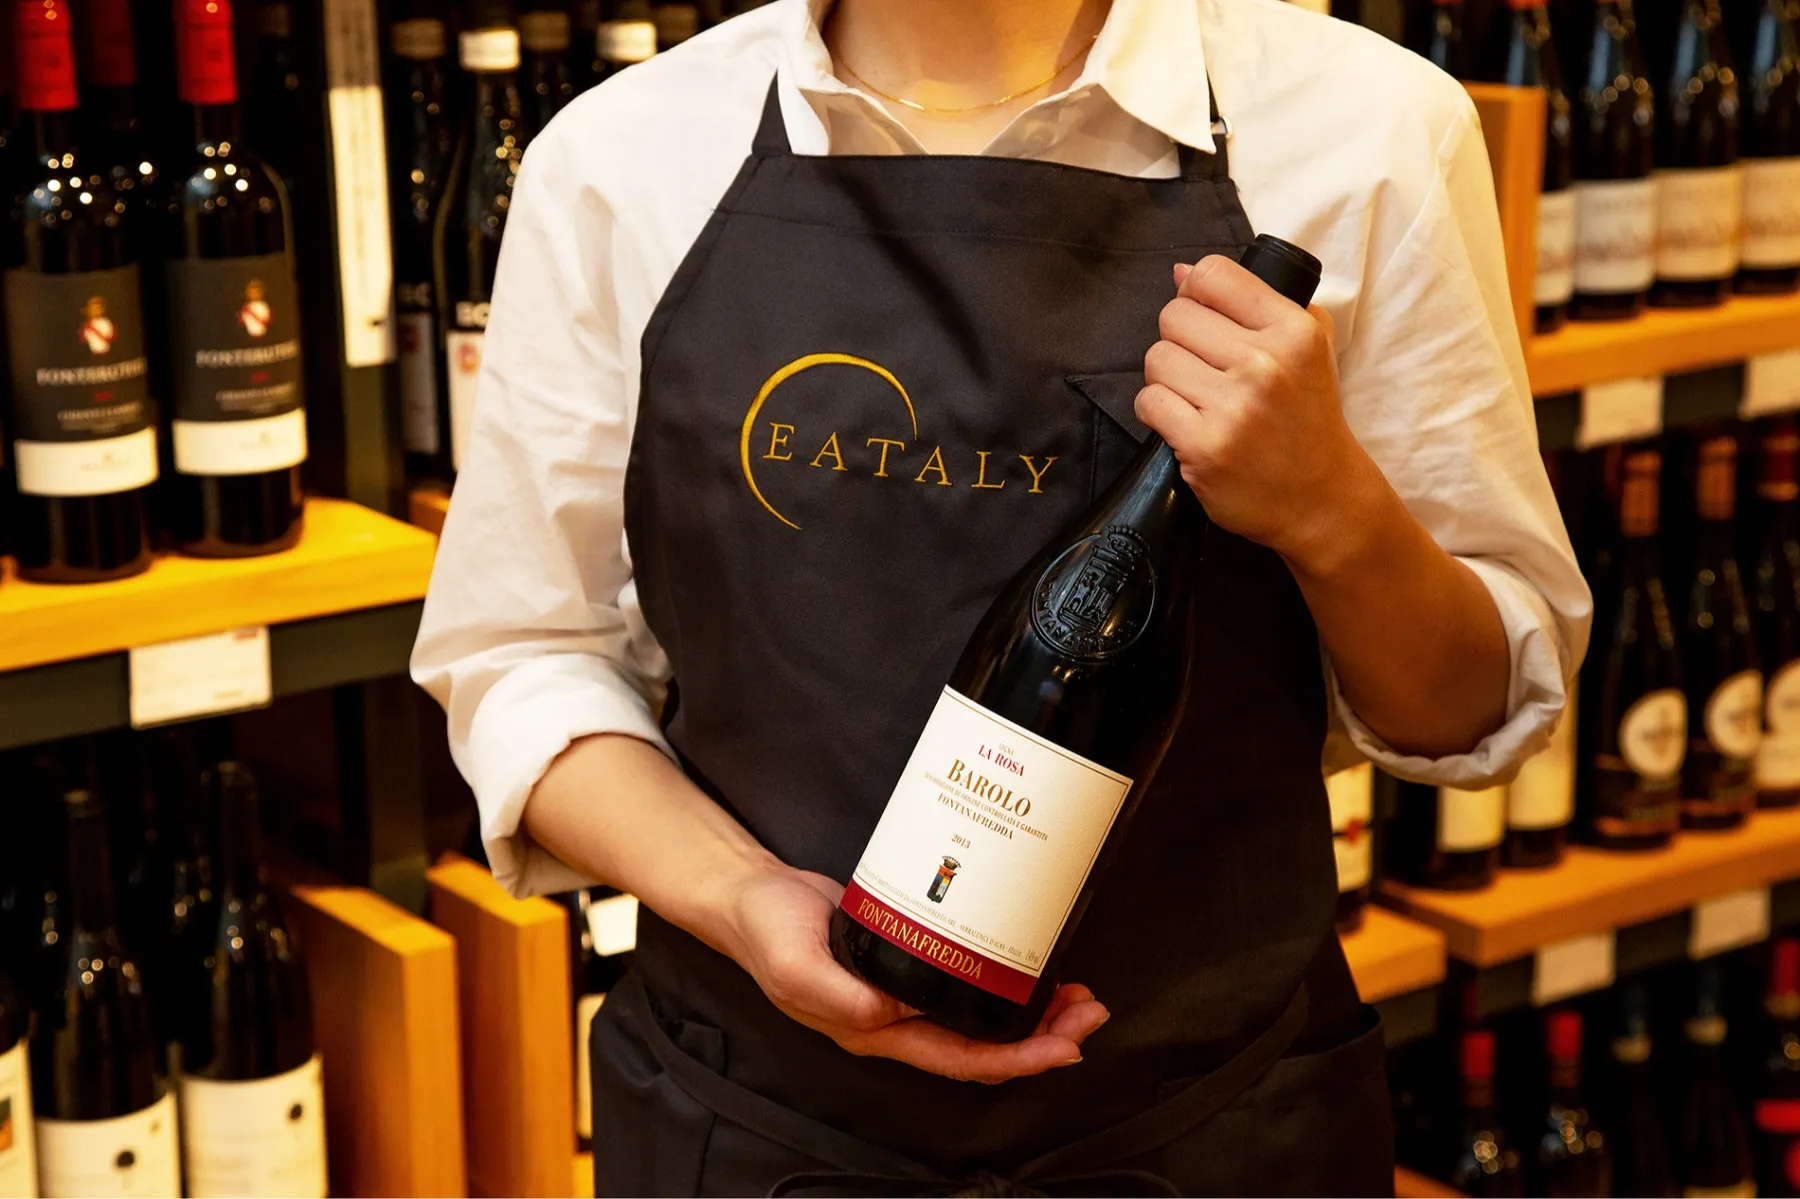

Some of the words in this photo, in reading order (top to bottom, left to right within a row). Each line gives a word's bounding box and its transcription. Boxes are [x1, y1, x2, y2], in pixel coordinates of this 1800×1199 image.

[763, 422, 1058, 494] EATALY
[978, 744, 992, 760] LA
[994, 753, 1024, 776] ROSA
[947, 758, 1031, 817] BAROLO
[938, 793, 1014, 840] FONTANAFREDDA
[1020, 823, 1048, 841] GARANTITA
[951, 833, 971, 849] 2013
[857, 898, 983, 980] FONTANAFREDDA
